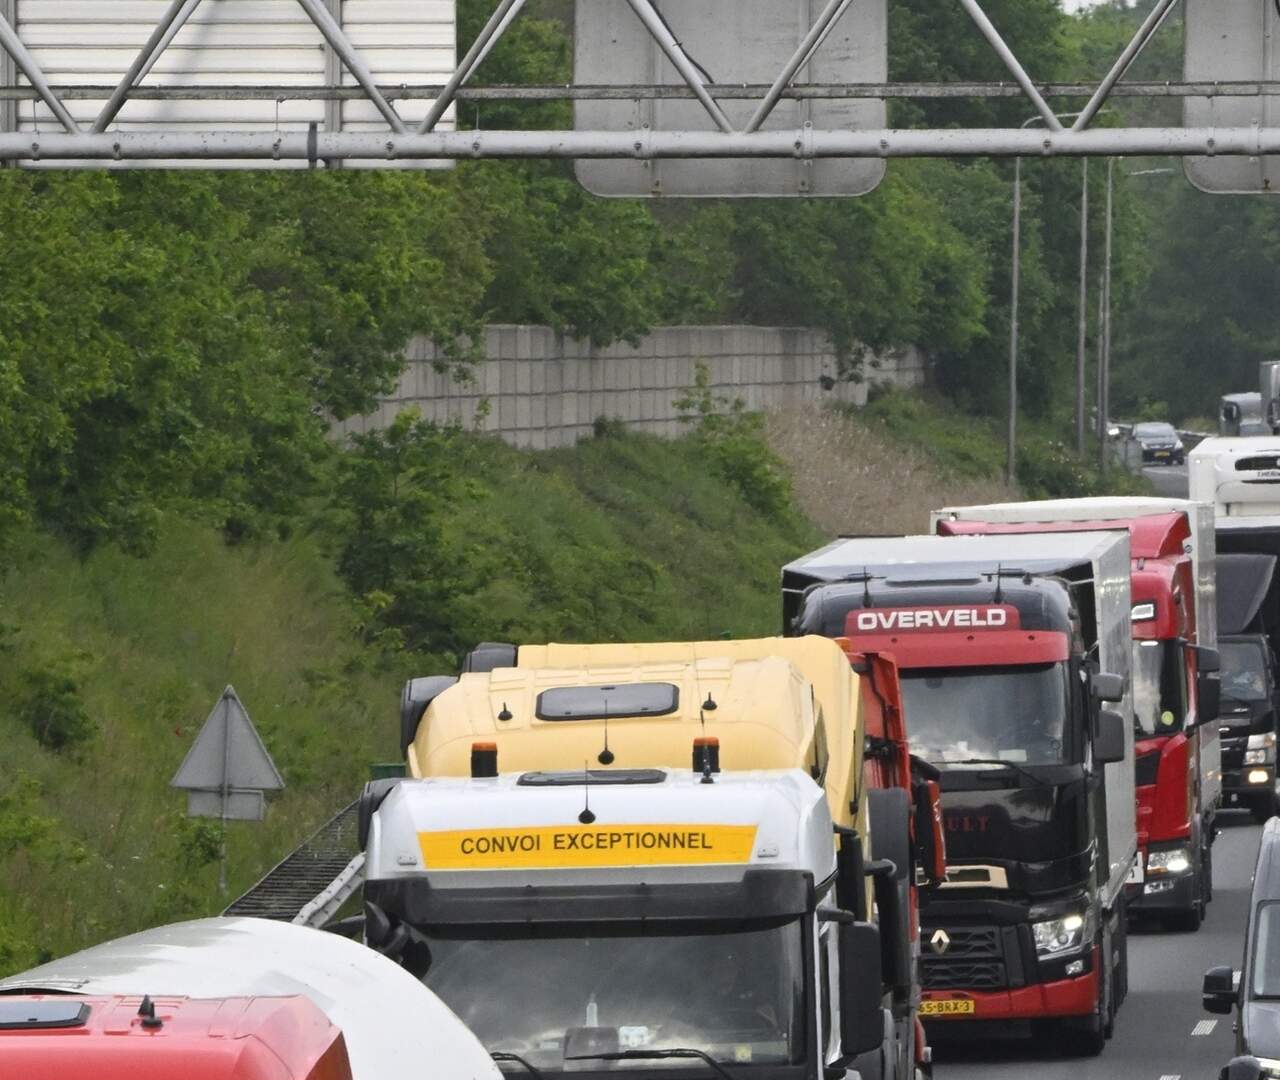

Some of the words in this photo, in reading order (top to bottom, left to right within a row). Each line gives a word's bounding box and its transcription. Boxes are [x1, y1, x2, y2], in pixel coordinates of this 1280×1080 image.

[857, 608, 1007, 631] OVERVELD
[460, 834, 541, 855] CONVOI
[552, 832, 713, 850] EXCEPTIONNEL
